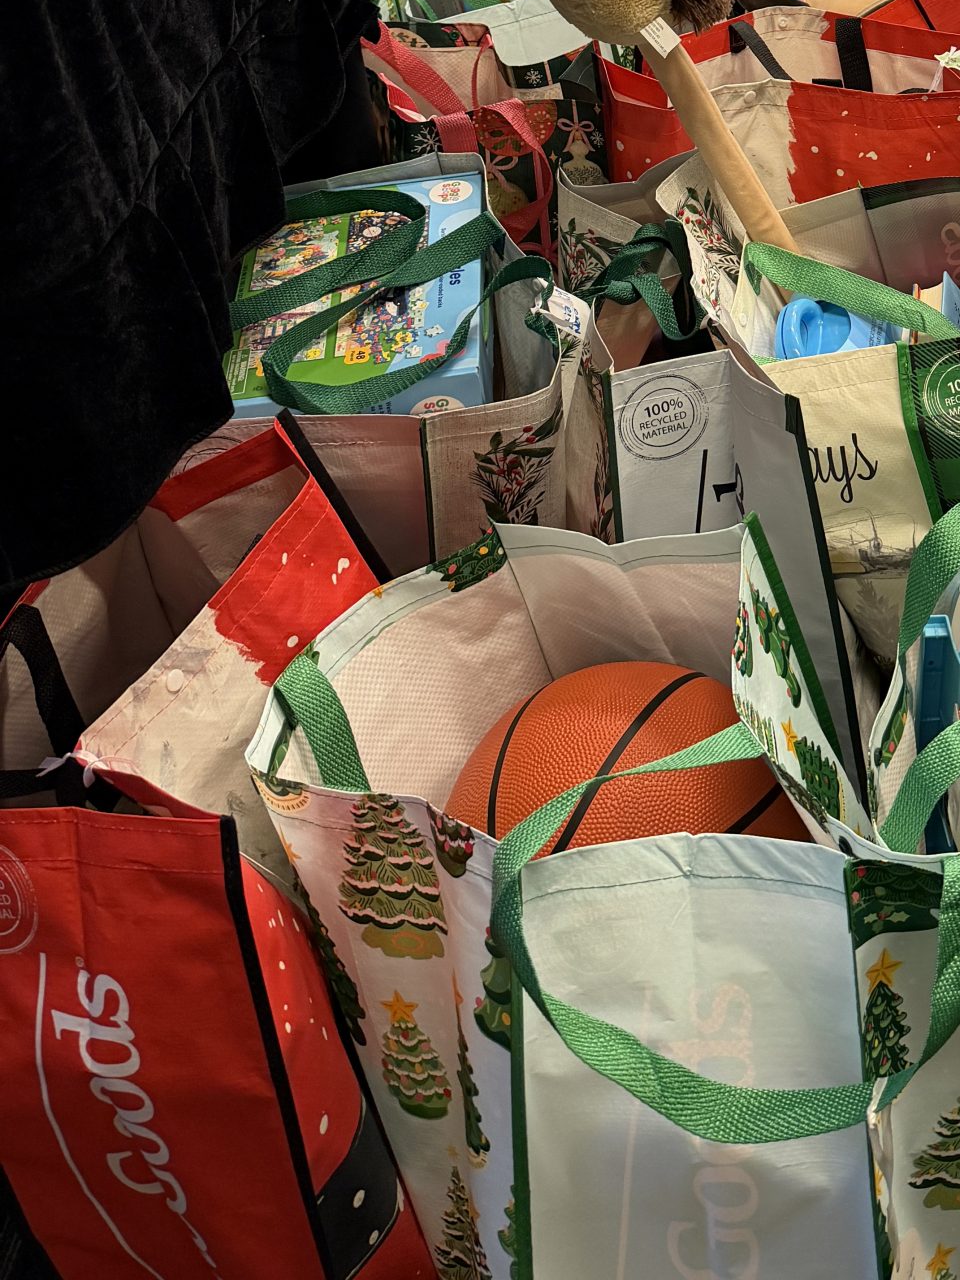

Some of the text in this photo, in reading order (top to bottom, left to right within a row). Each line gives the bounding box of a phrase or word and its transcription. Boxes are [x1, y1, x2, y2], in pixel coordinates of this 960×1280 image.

[644, 396, 684, 419] 100%
[639, 410, 687, 431] RECYCLED
[642, 421, 689, 441] MATERIAL
